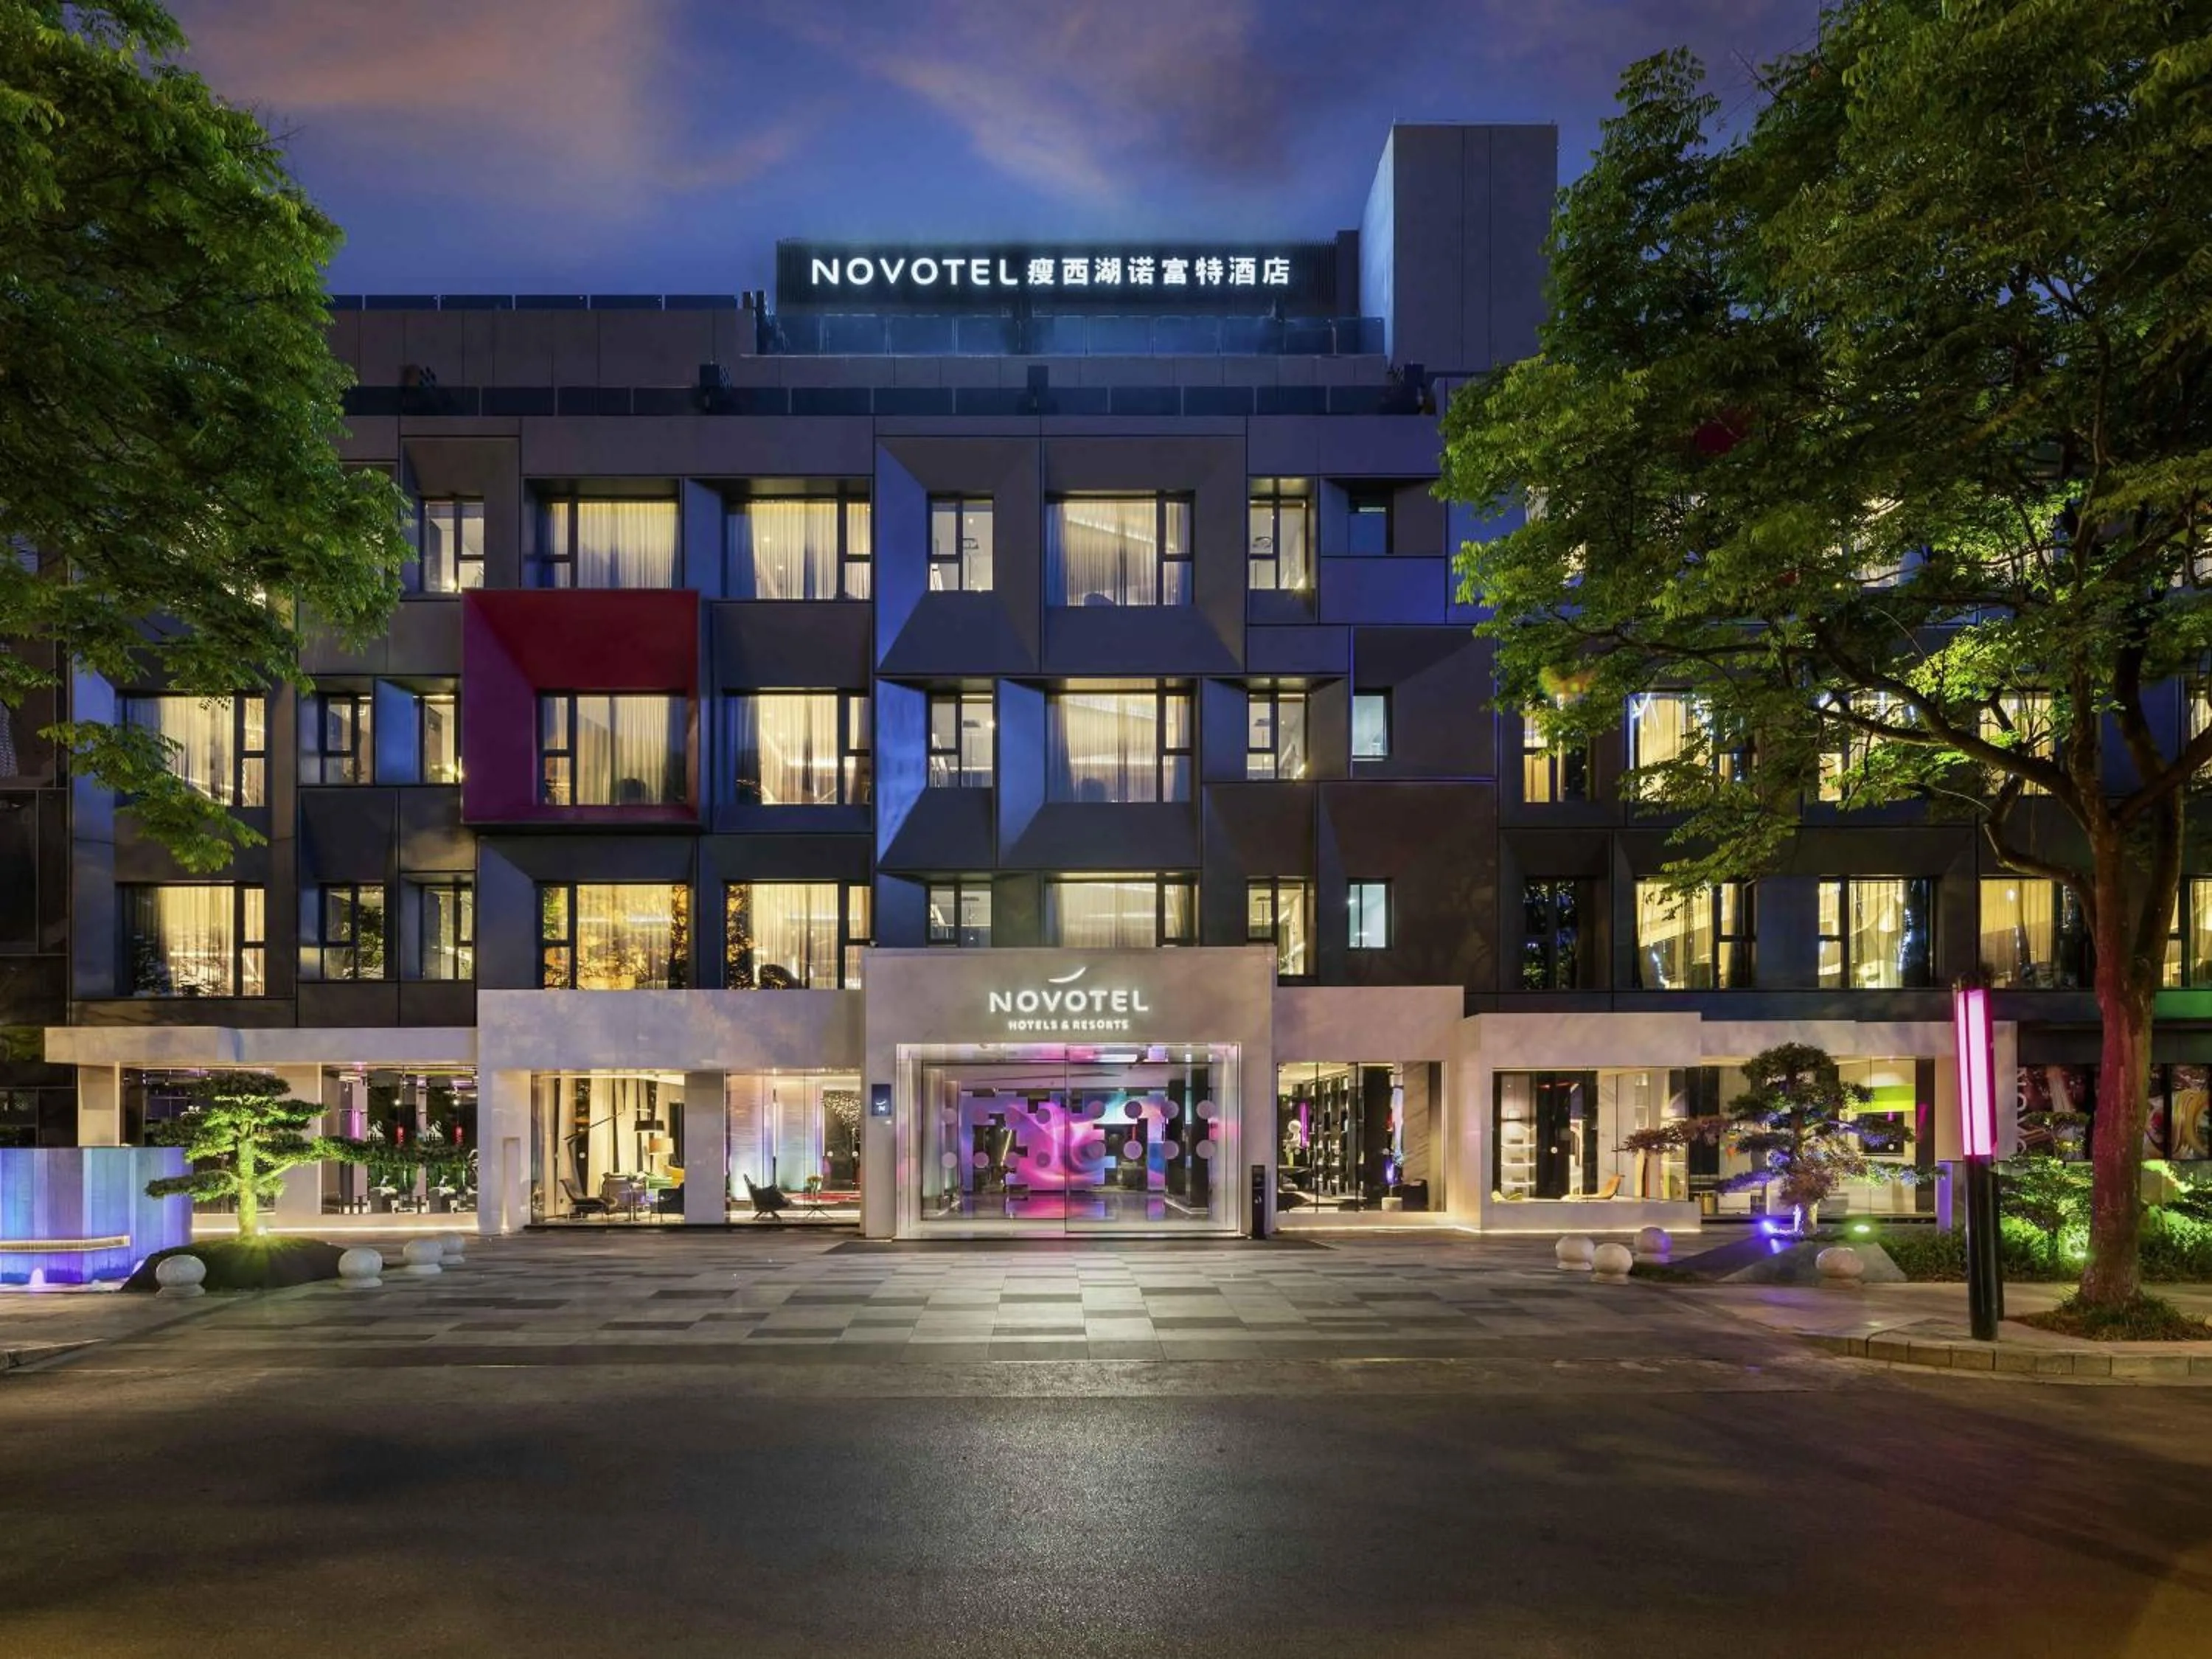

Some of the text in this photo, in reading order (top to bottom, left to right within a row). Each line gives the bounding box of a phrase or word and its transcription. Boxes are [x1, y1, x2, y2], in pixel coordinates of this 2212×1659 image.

[812, 256, 1290, 285] NOVOTEL 瘦西湖诺富特酒店
[989, 990, 1149, 1012] NOVOTEL
[1007, 1019, 1058, 1031] HOTELS
[1072, 1019, 1129, 1031] RESORTS
